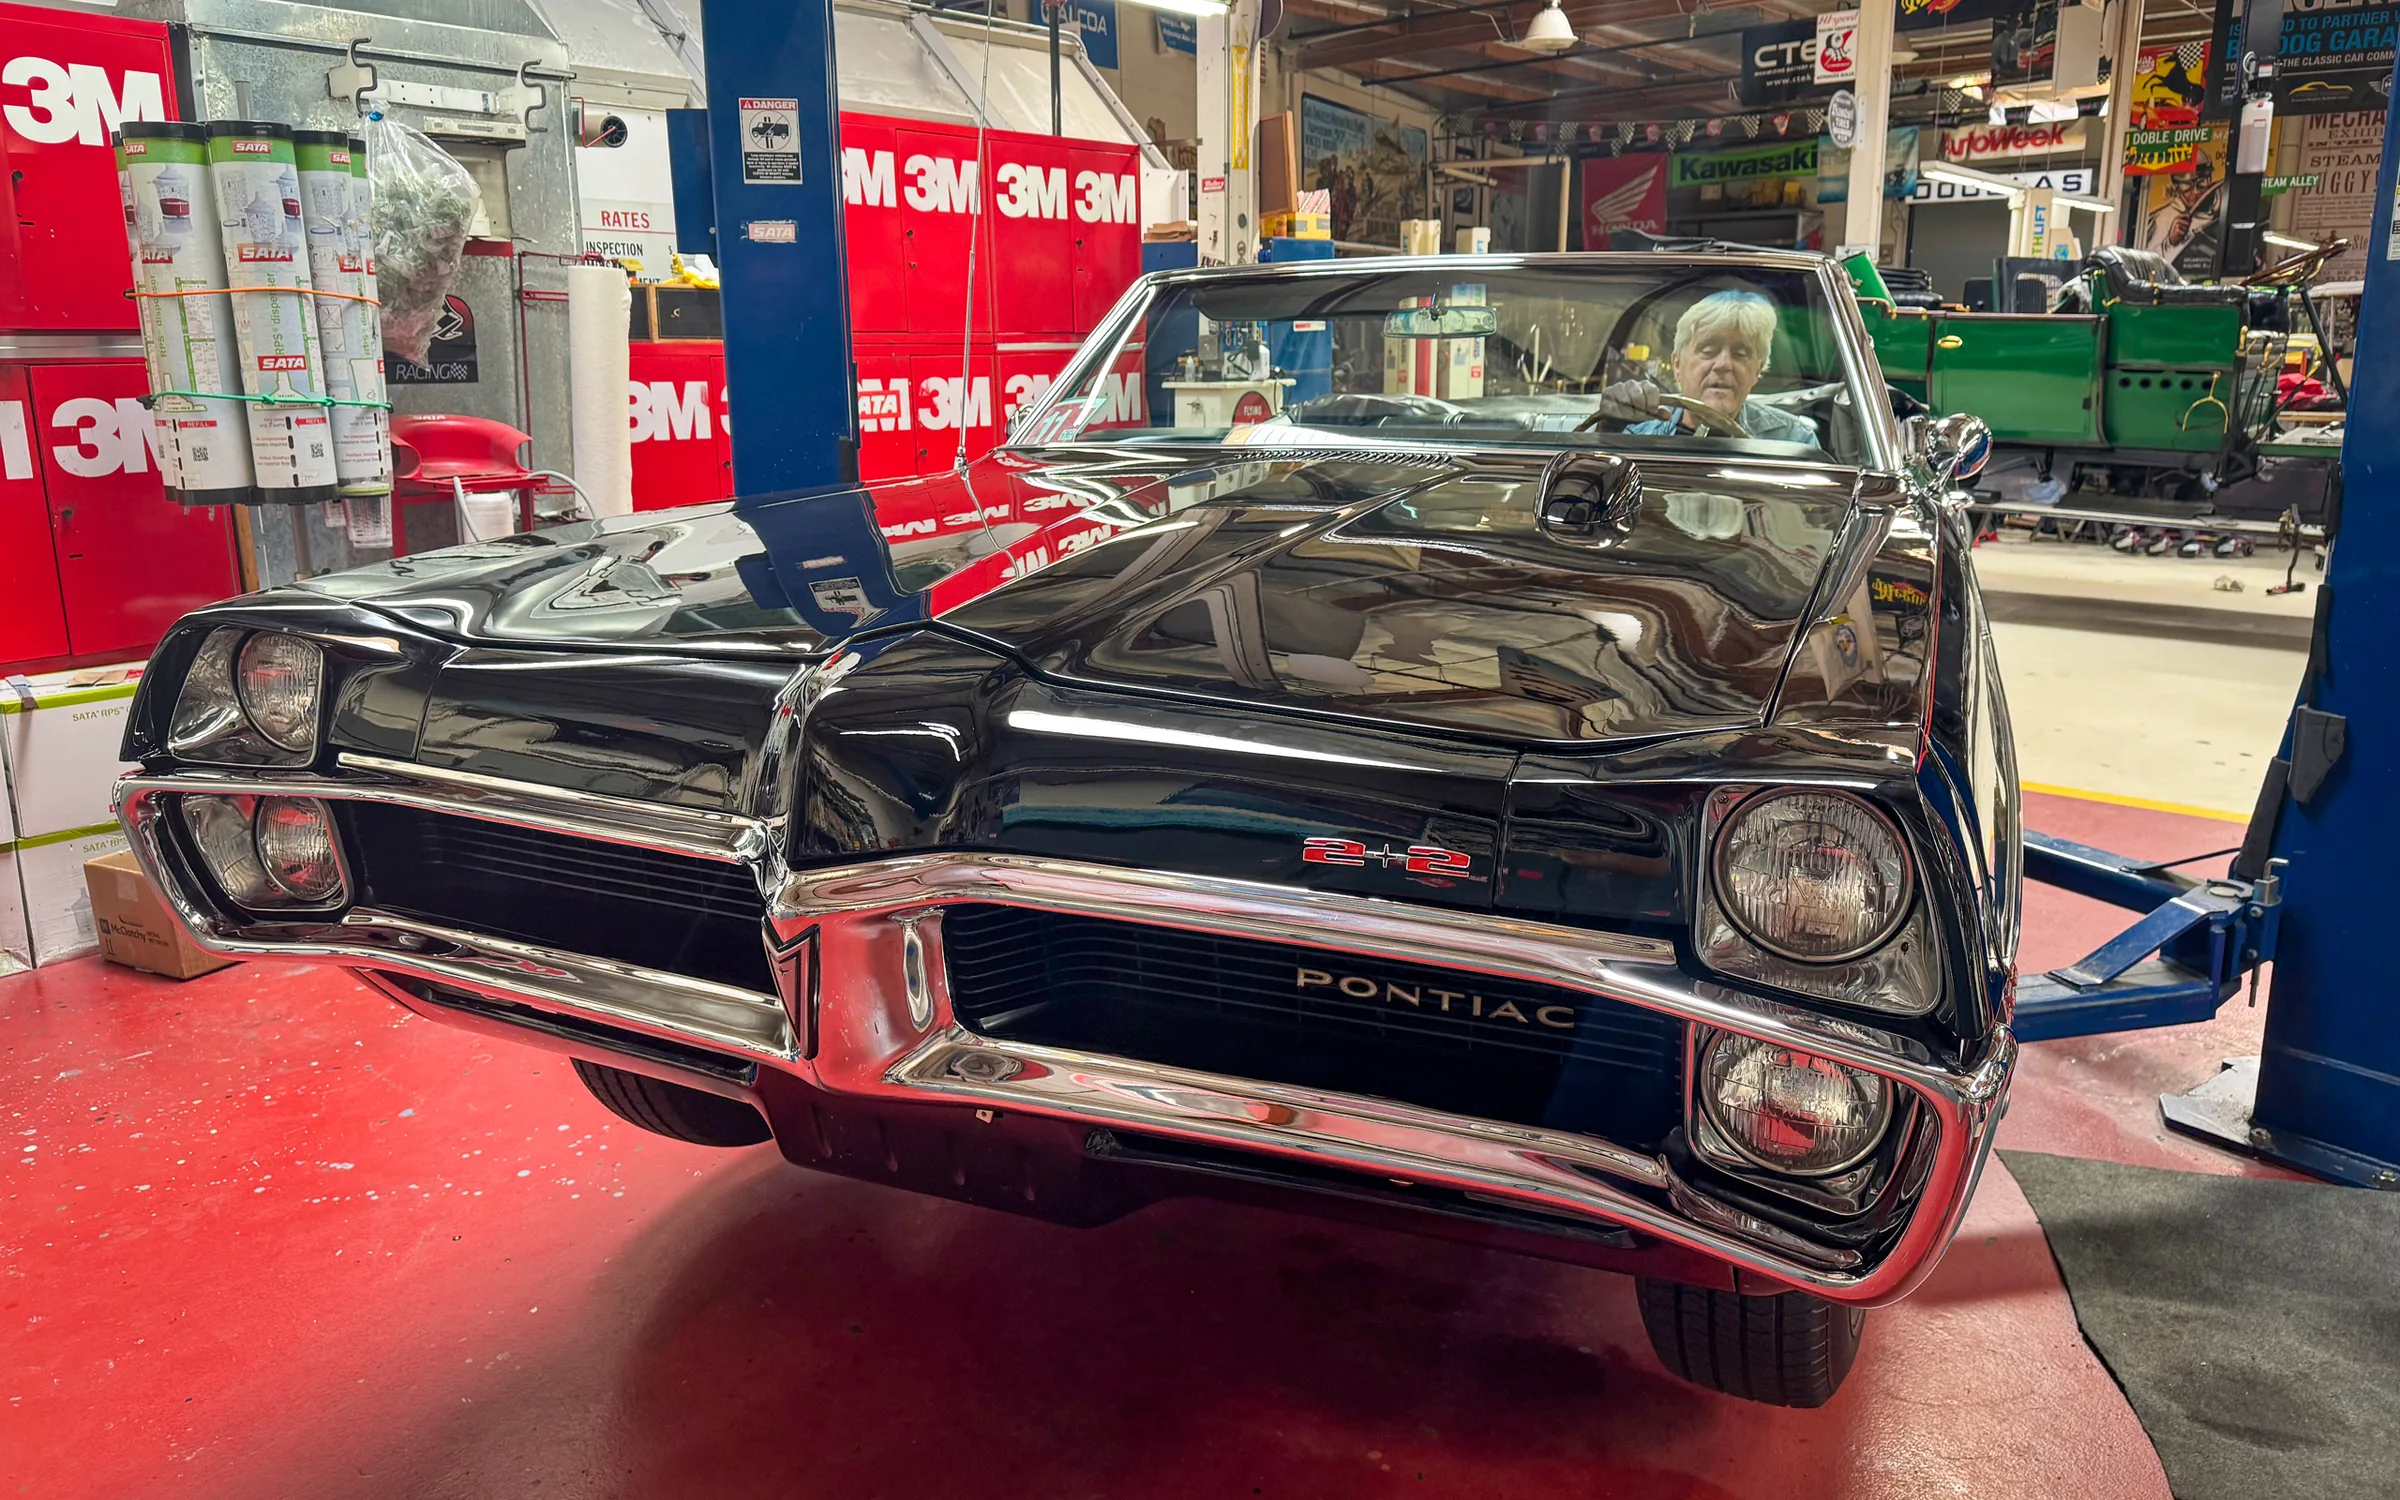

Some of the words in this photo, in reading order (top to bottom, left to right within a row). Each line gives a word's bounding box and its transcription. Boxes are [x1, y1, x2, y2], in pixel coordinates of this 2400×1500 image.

[2300, 17, 2317, 30] TO
[2322, 11, 2390, 29] PARTNER
[2283, 58, 2300, 67] THE
[2302, 54, 2343, 66] CLASSIC
[2345, 52, 2364, 63] CAR
[2, 56, 166, 146] 3M
[753, 100, 796, 109] DANGER
[2133, 130, 2170, 145] DOBLE
[2174, 127, 2208, 142] DRIVE
[235, 142, 269, 153] SATA
[2310, 152, 2381, 168] STEAM
[903, 153, 982, 215] 3M
[2290, 175, 2320, 187] ALLEY
[996, 161, 1069, 221] 3M
[1074, 169, 1137, 225] 3M
[601, 210, 650, 229] RATES
[753, 227, 793, 238] SATA
[242, 246, 291, 259] SATA
[585, 240, 644, 257] INSPECTION
[272, 332, 285, 355] RPS
[262, 356, 305, 370] SATA
[396, 363, 450, 380] RACING
[859, 393, 898, 414] ATA
[917, 376, 992, 431] 3M
[1303, 836, 1471, 878] 2+2
[111, 924, 146, 944] McClatchy
[1297, 967, 1576, 1028] PONTIAC
